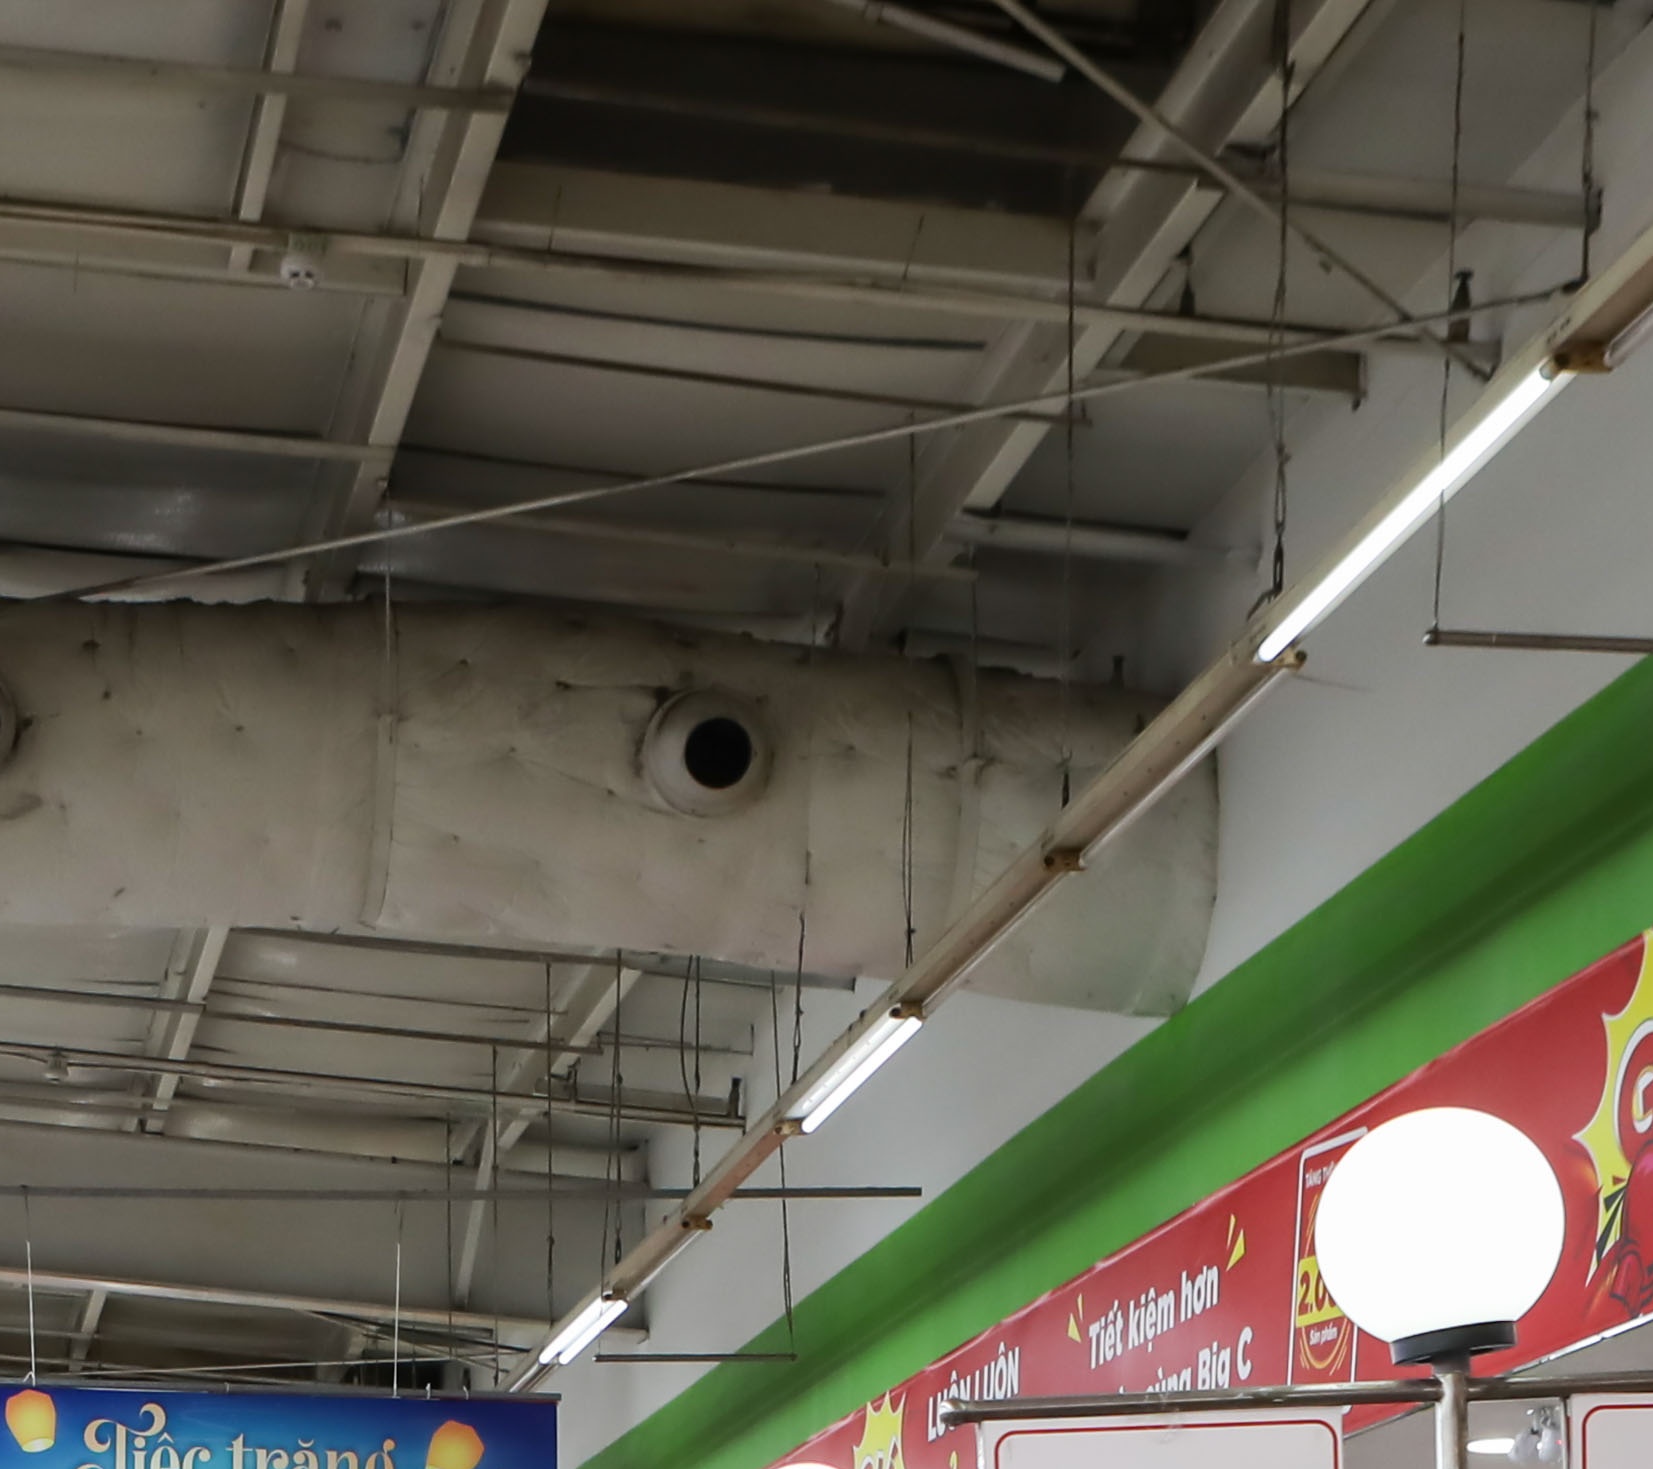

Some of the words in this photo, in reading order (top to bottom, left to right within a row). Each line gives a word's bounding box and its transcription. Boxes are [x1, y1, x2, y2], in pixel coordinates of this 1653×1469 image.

[1088, 1299, 1125, 1370] Tiết
[1127, 1285, 1176, 1352] kiệm
[1180, 1264, 1220, 1325] hơn
[1236, 1326, 1254, 1380] C
